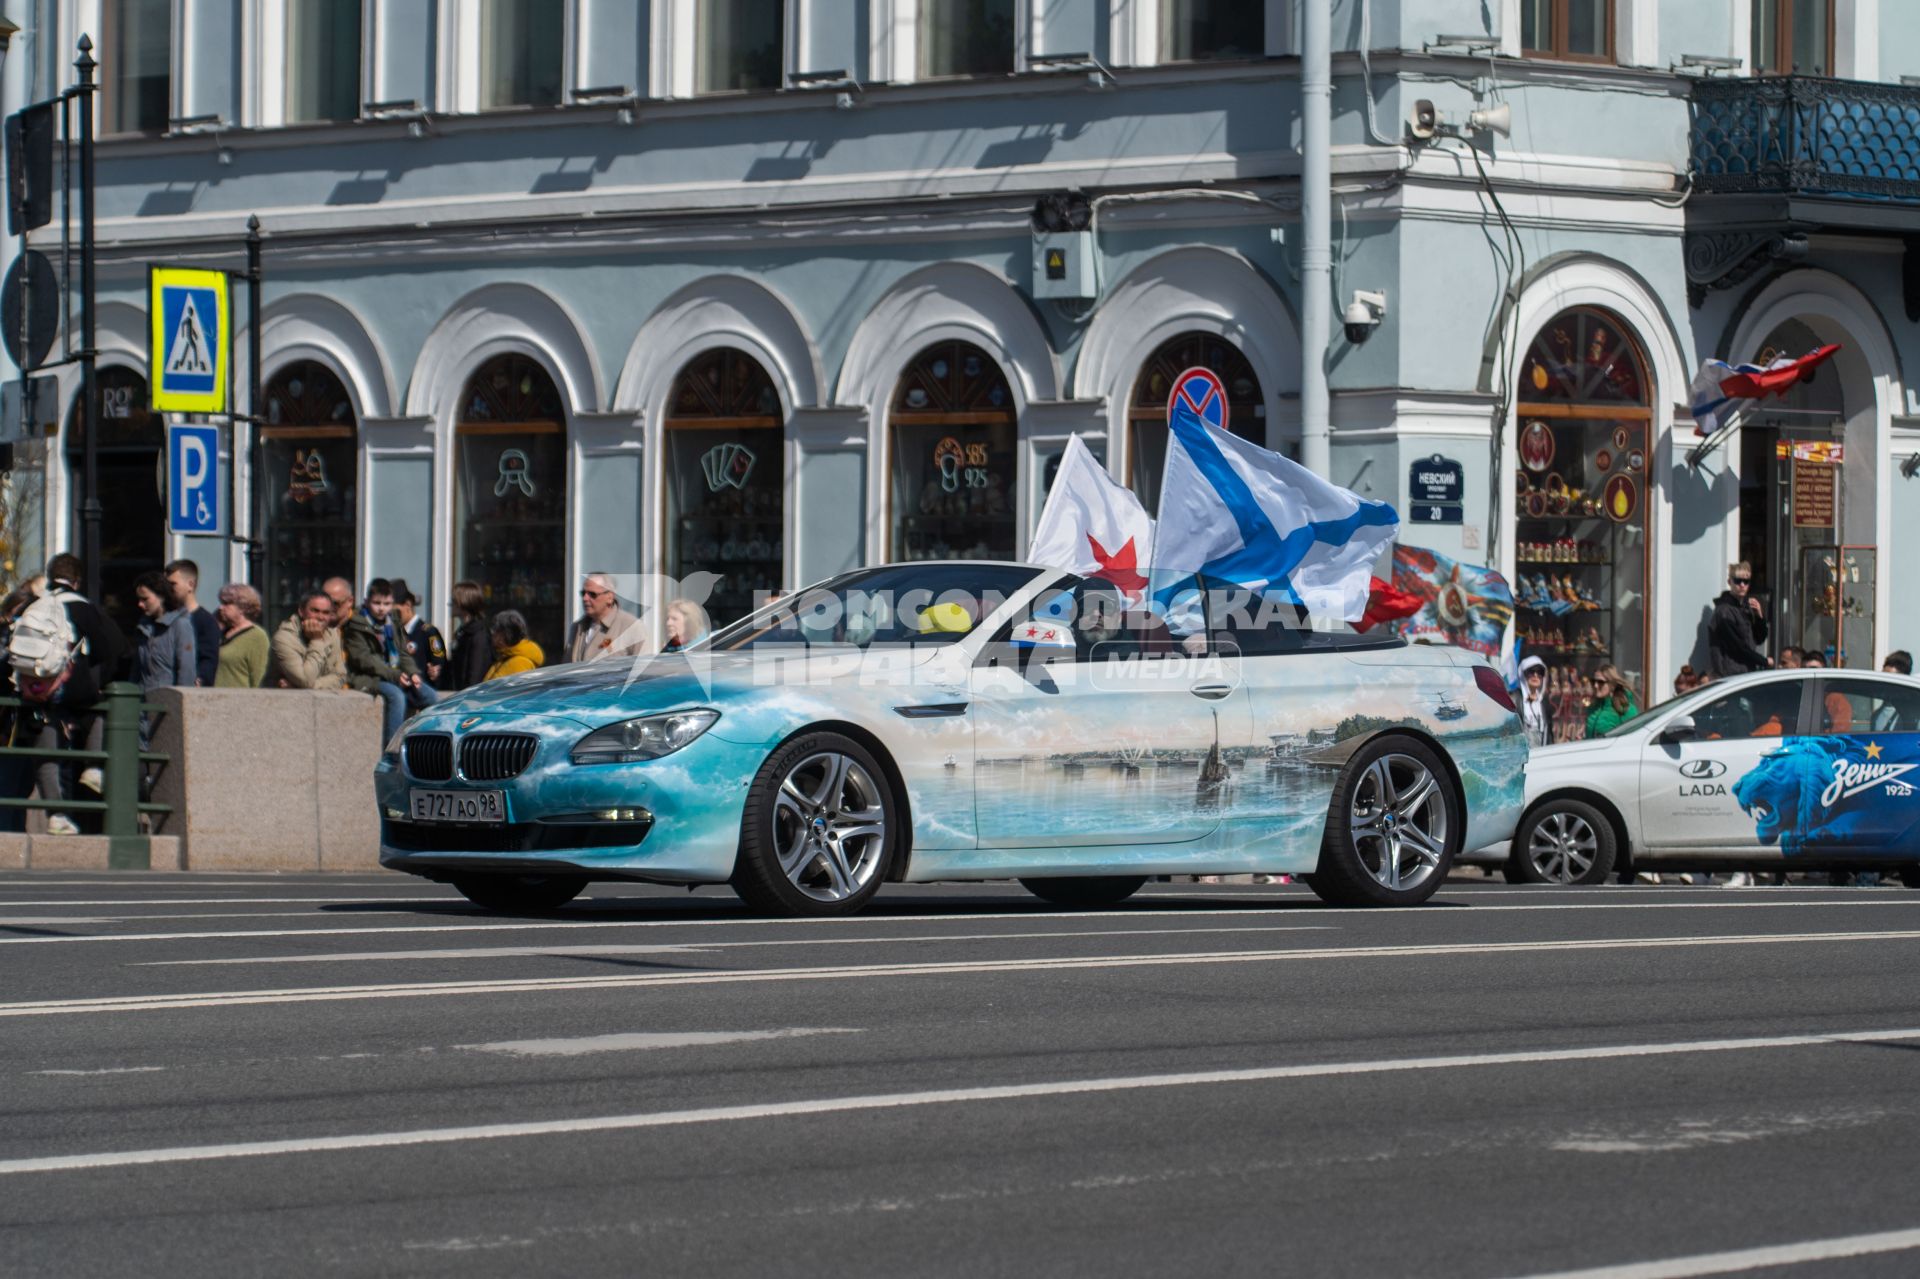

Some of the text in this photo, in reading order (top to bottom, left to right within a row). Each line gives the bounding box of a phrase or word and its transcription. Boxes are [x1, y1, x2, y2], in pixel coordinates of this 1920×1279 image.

[965, 443, 988, 466] 585
[180, 434, 208, 518] P
[964, 467, 988, 488] 925
[1418, 470, 1456, 486] НЕВСКИЙ
[1430, 506, 1442, 520] 20
[1679, 783, 1727, 797] LADA
[1884, 784, 1912, 797] 1925
[480, 794, 497, 812] 98
